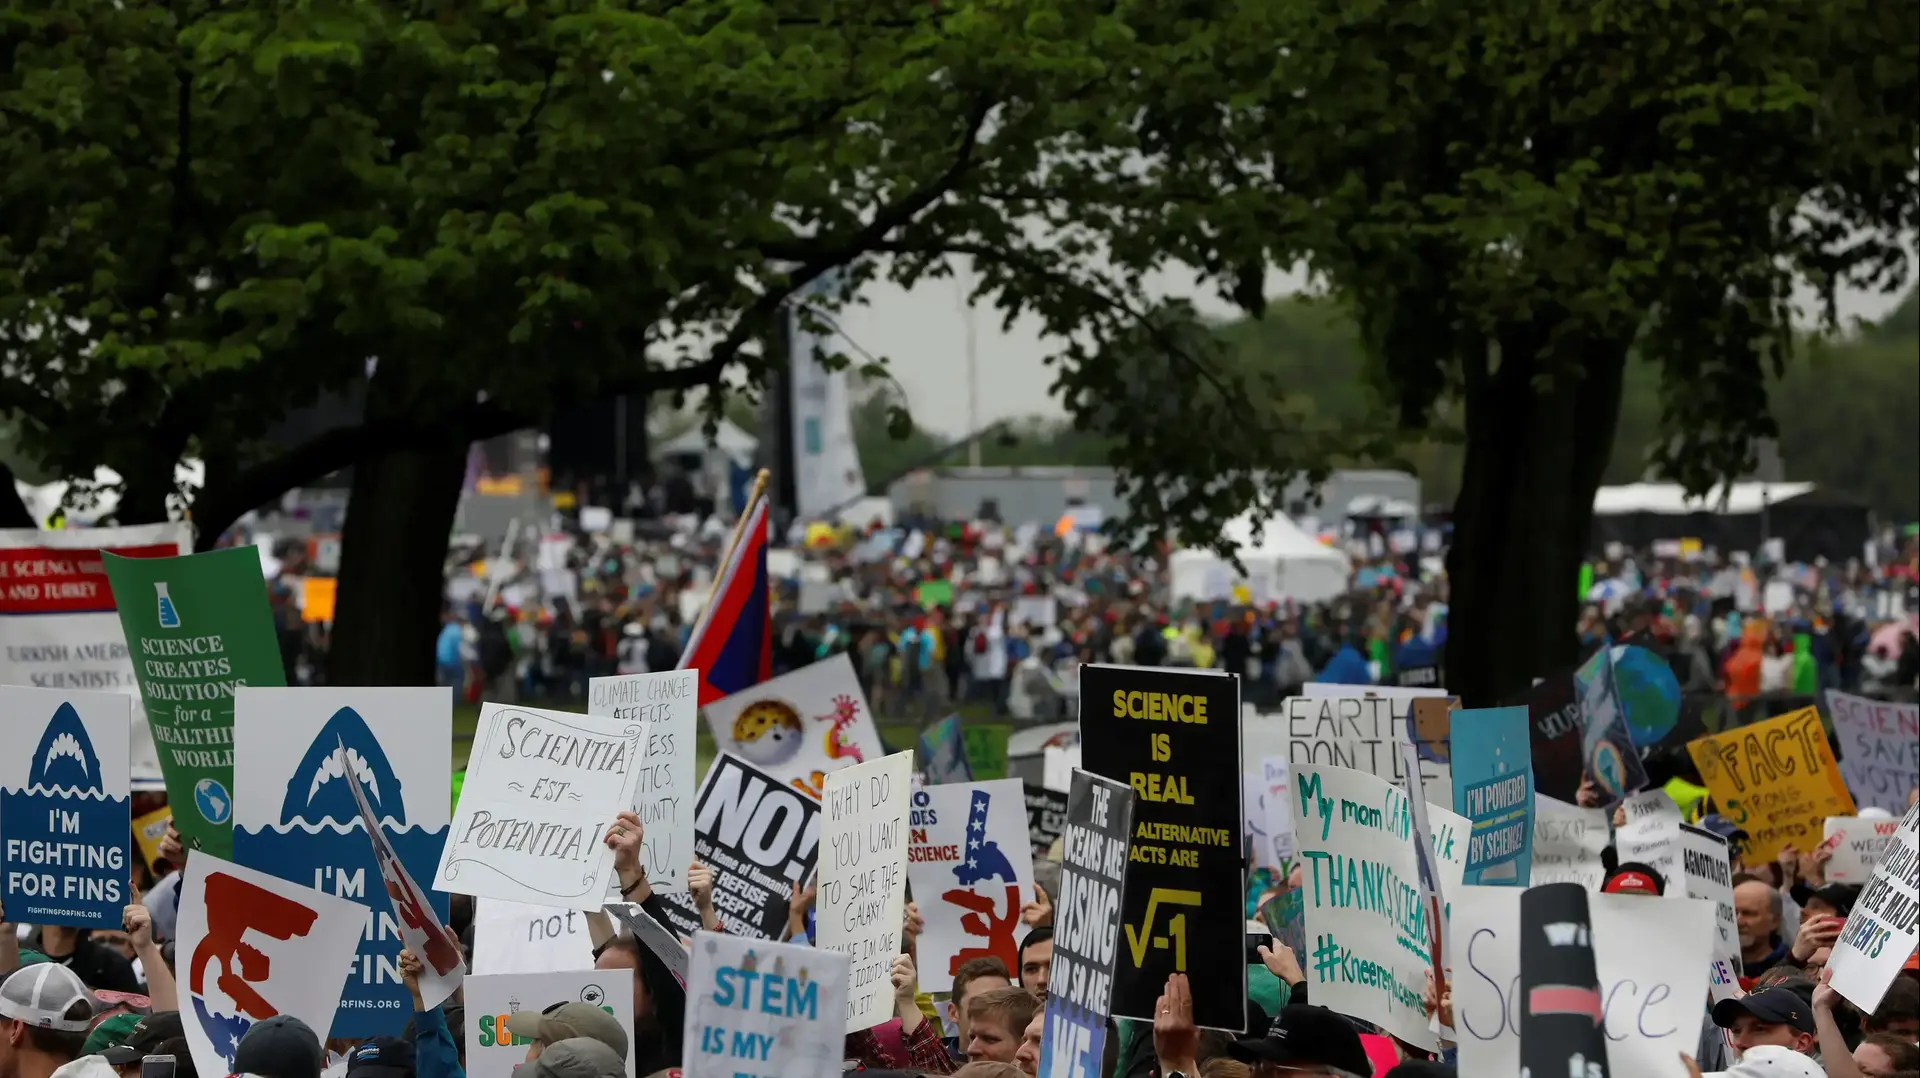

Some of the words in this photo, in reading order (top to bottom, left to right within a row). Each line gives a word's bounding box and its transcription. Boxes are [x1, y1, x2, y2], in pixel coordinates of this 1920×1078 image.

[44, 581, 98, 599] TURKEY
[141, 635, 224, 656] SCIENCE
[145, 657, 231, 678] CREATES
[593, 680, 641, 708] CLIMATE
[647, 677, 691, 701] CHANGE
[1113, 689, 1208, 724] SCIENCE
[174, 704, 198, 726] for
[201, 708, 213, 721] a
[1290, 698, 1415, 737] EARTH
[154, 724, 234, 745] HEALTHI
[499, 717, 627, 775] SCIENTIA
[1151, 733, 1171, 762] IS
[530, 777, 570, 802] EST
[871, 773, 890, 810] DO
[910, 791, 930, 807] O
[1091, 784, 1111, 829] THE
[1130, 772, 1195, 805] REAL
[1466, 787, 1484, 818] I'M
[1485, 774, 1526, 814] POWERED
[49, 808, 80, 834] I'M
[695, 762, 821, 881] NO!
[1297, 772, 1335, 841] My
[1341, 798, 1383, 831] mom
[1385, 788, 1411, 842] CAN
[460, 810, 605, 863] POTENTIA!
[832, 830, 861, 871] YOU
[869, 817, 901, 854] WANT
[1136, 821, 1230, 847] ALTERNATIVE
[1471, 834, 1485, 865] BY
[1486, 821, 1524, 861] SCIENCE!
[7, 839, 123, 871] FIGHTING
[696, 838, 710, 857] the
[709, 847, 738, 871] Name
[737, 864, 752, 876] of
[908, 845, 960, 863] SCIENCE
[1064, 823, 1104, 873] OCEANS
[1102, 837, 1125, 882] ARE
[1129, 844, 1167, 865] ACTS
[1169, 849, 1200, 868] ARE
[1683, 847, 1730, 888] AGNOTOLOGY
[9, 872, 56, 898] FOR
[64, 876, 121, 903] FINS
[314, 866, 365, 898] I'M
[717, 870, 770, 907] REFUSE
[822, 879, 842, 910] TO
[849, 868, 876, 901] SAVE
[881, 861, 899, 894] THE
[27, 906, 103, 919] FIGHTINGFORFINS.ORG
[711, 886, 755, 925] CCEPT
[752, 910, 765, 927] A
[1054, 868, 1119, 966] RISING
[1394, 875, 1428, 947] SCIENC
[528, 908, 577, 942] not
[713, 965, 819, 1021] STEM
[1049, 953, 1071, 999] AND
[1070, 962, 1087, 1005] SO
[1085, 969, 1111, 1017] ARE
[702, 1025, 725, 1055] IS
[731, 1031, 775, 1061] MY
